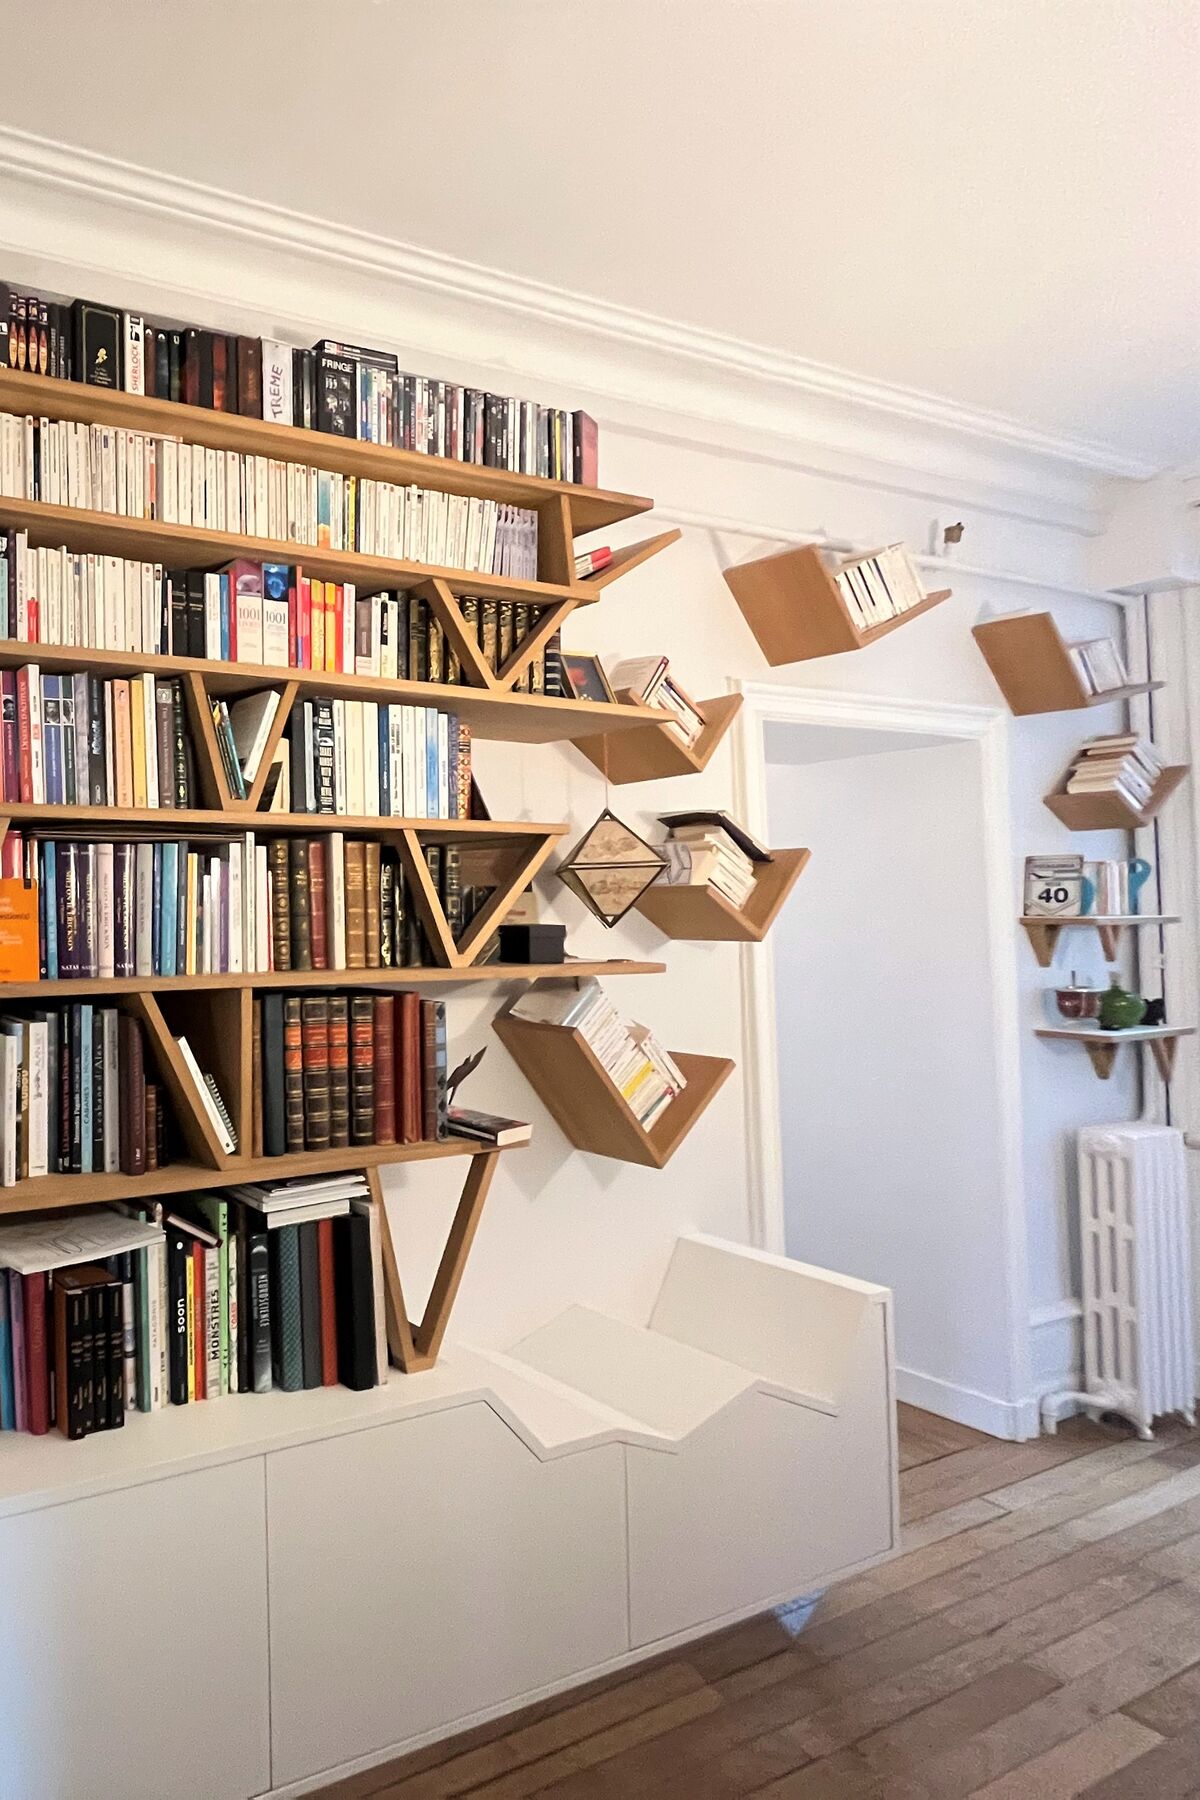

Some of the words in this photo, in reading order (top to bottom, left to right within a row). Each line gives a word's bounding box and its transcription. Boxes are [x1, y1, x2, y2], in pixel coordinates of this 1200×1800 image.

[131, 344, 140, 391] SHERLOCK
[322, 357, 354, 374] FRINGE
[270, 364, 282, 419] TREME
[238, 607, 260, 620] 1001
[266, 610, 286, 625] 1001
[1038, 887, 1068, 904] 40
[94, 1044, 104, 1081] d'Alex
[94, 1086, 104, 1122] cabane
[94, 1124, 104, 1142] La
[176, 1298, 186, 1334] soon
[258, 1274, 270, 1326] NEUROSCIENCE
[210, 1289, 220, 1360] MONSTRES
